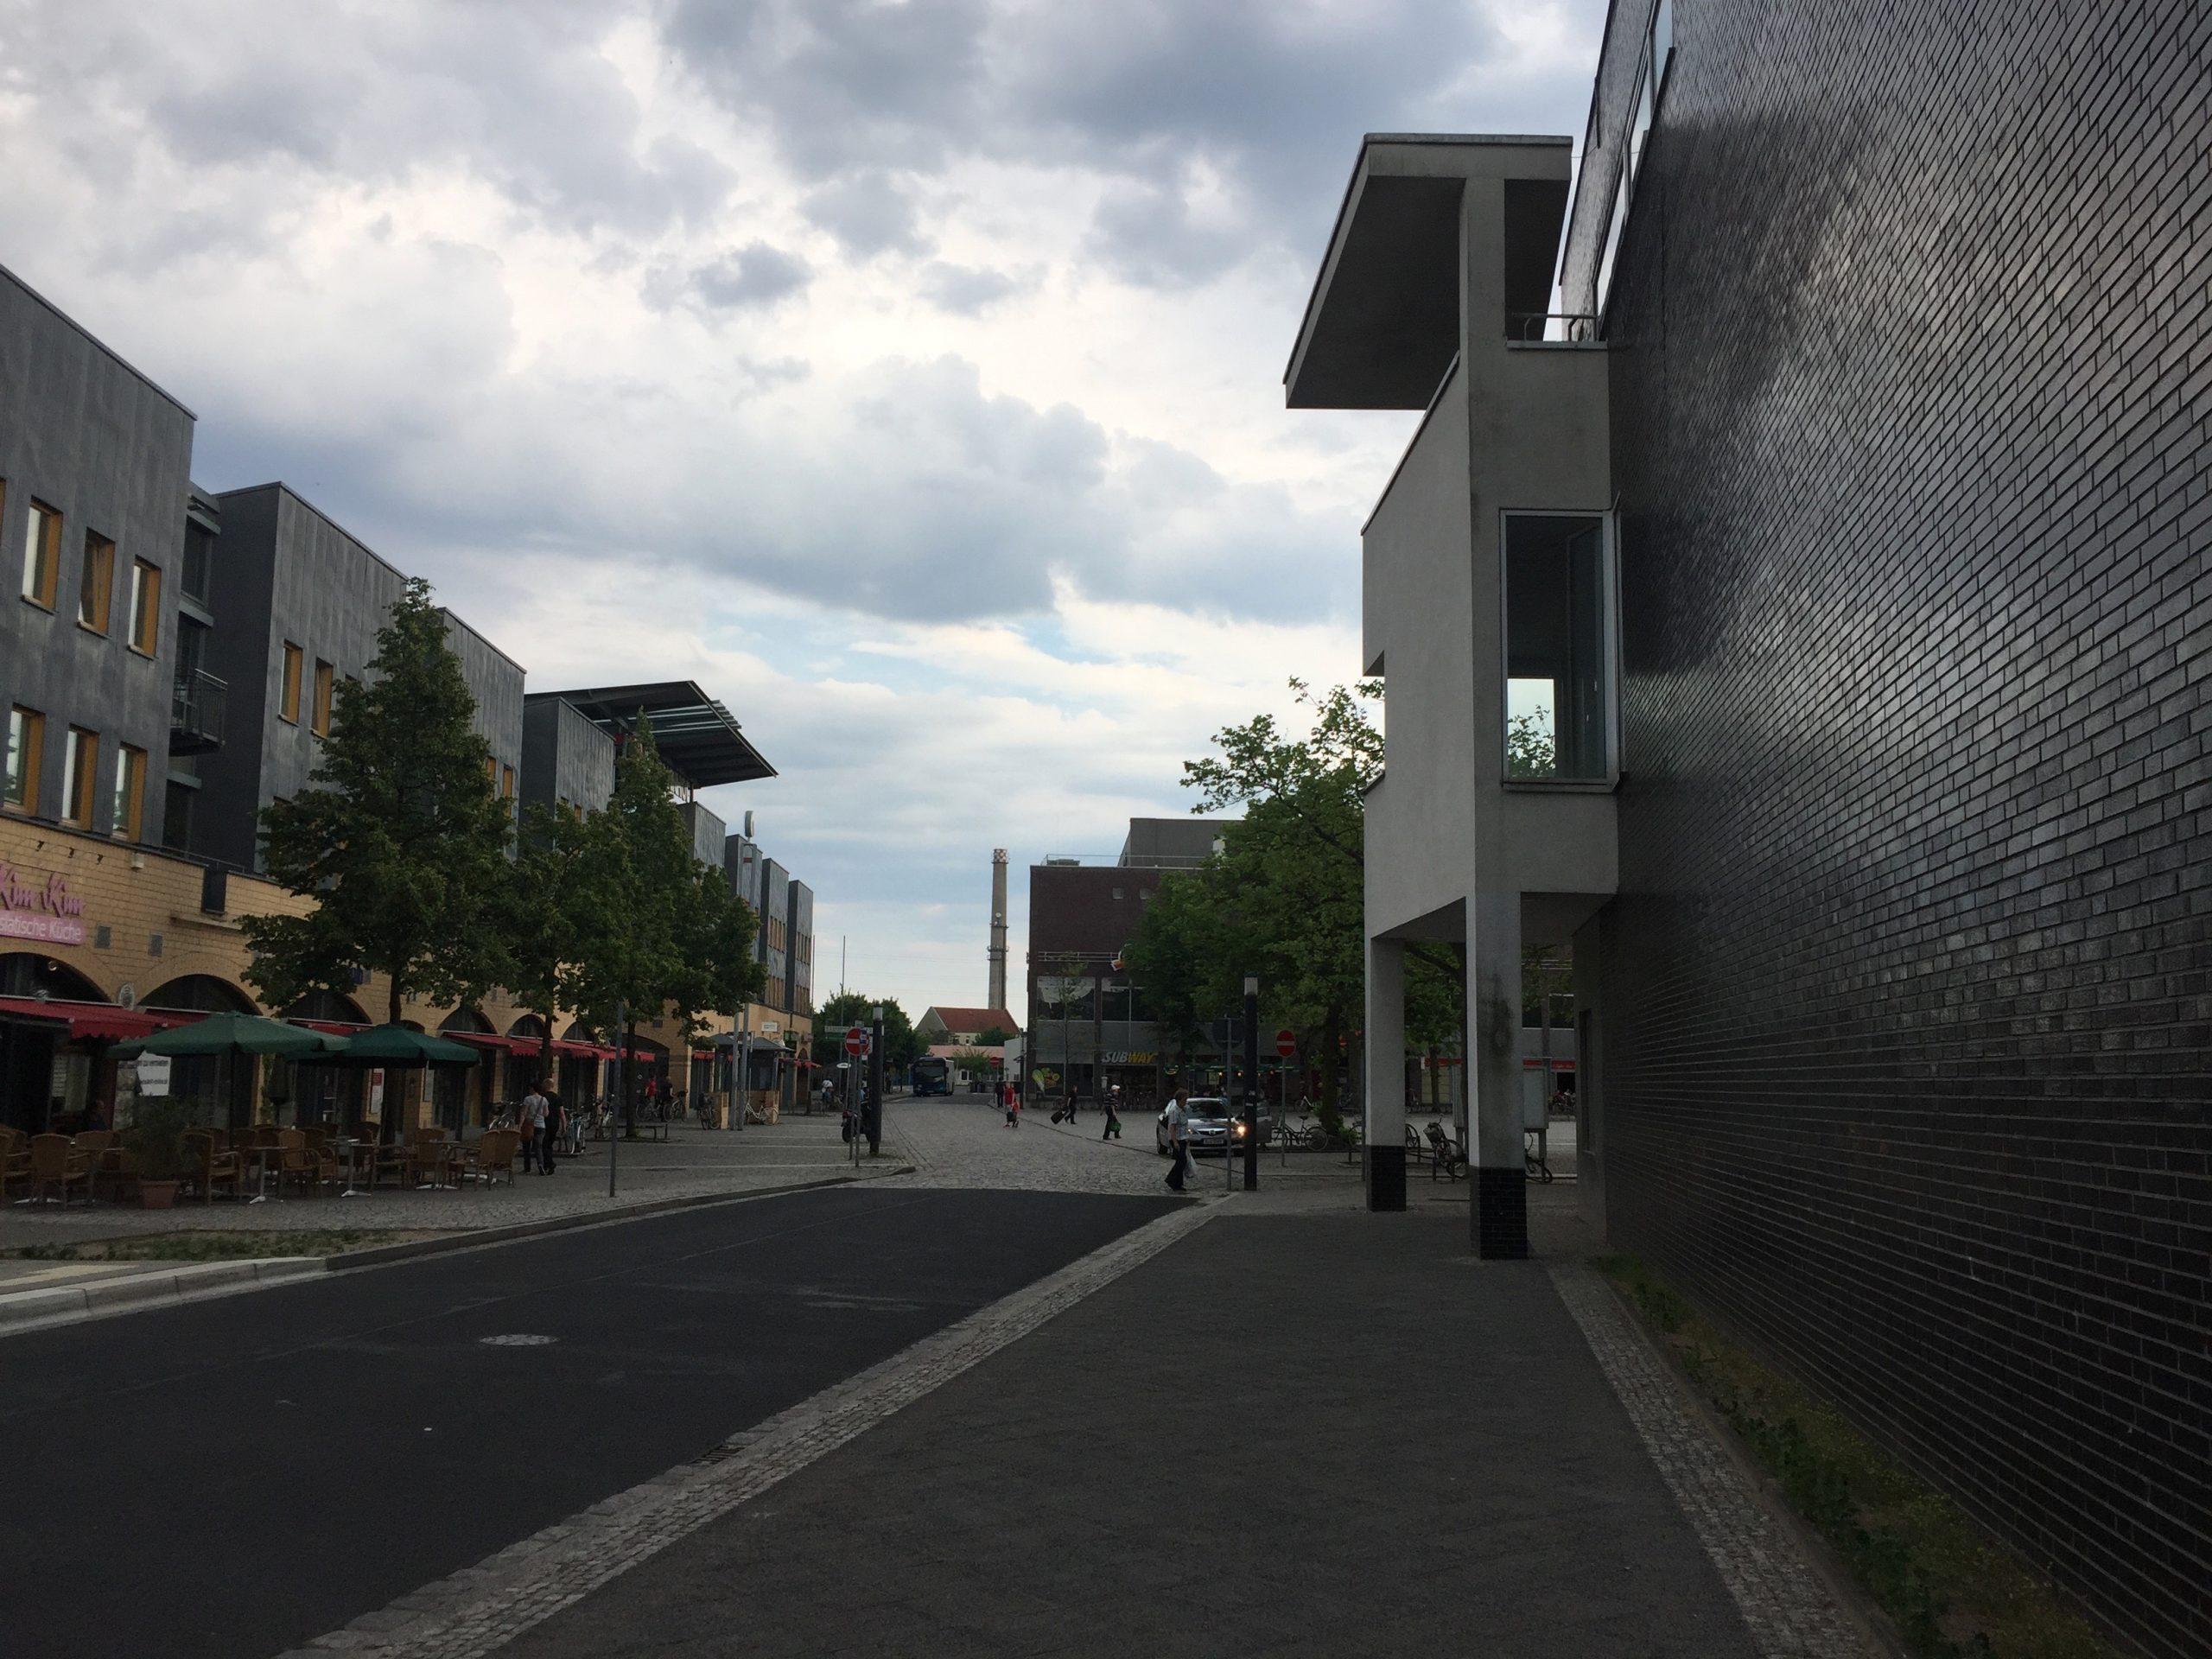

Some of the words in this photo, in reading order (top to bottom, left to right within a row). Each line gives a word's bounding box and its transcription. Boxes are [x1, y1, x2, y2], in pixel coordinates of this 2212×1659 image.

[41, 872, 83, 918] Kim
[49, 920, 82, 942] Küche
[1102, 1051, 1158, 1064] SUBWAY
